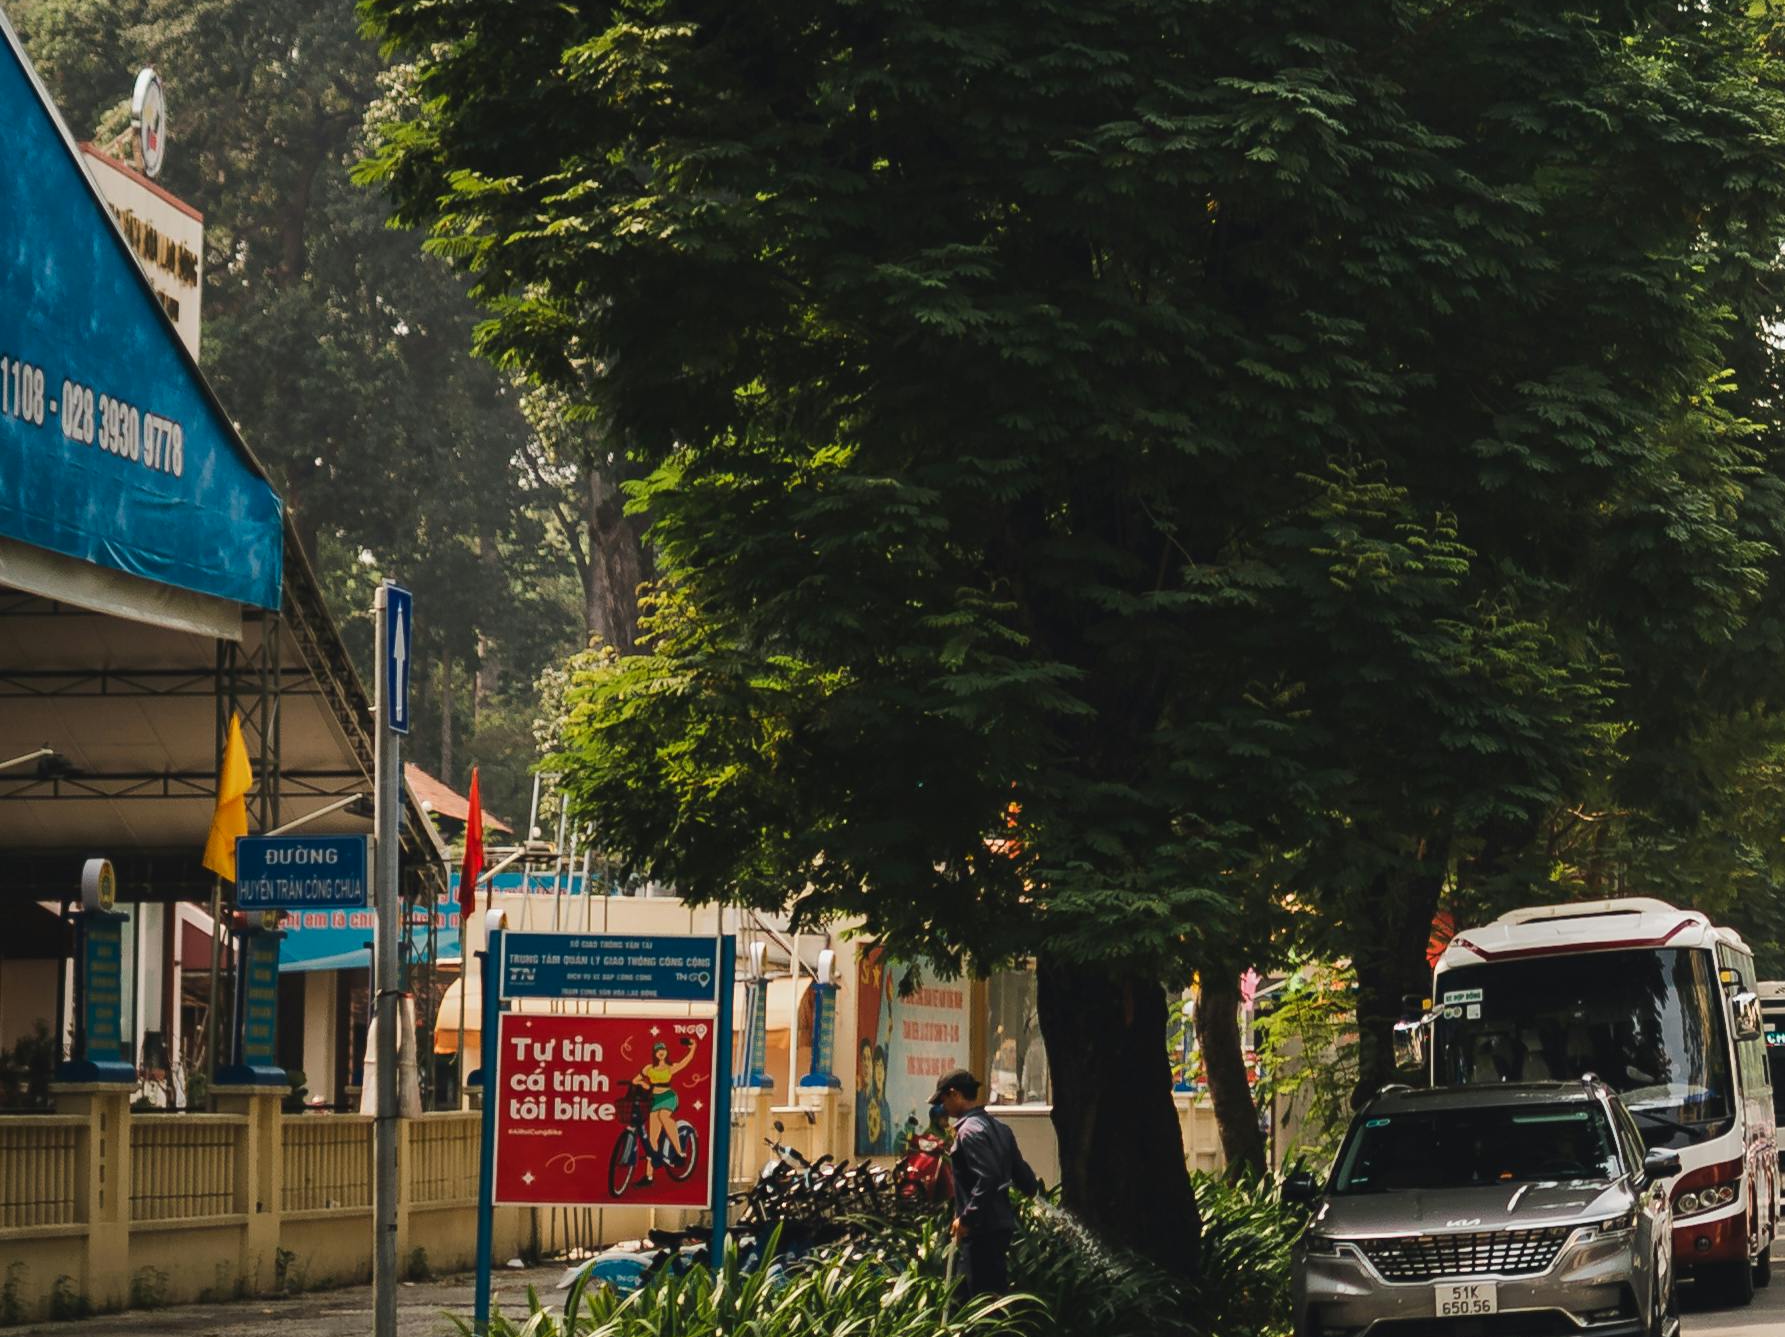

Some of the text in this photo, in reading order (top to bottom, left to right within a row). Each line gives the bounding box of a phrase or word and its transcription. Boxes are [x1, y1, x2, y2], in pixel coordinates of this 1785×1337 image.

[61, 380, 94, 444] 028
[98, 394, 139, 461] 3930
[143, 413, 183, 477] 9778
[265, 845, 338, 865] ĐƯỜNG
[509, 954, 538, 965] TRUNG
[603, 956, 624, 967] GIAO
[510, 1035, 603, 1068] Tự tin
[510, 1068, 609, 1092] cá tính
[509, 1096, 616, 1121] tôi bike
[1452, 1286, 1479, 1300] 51K
[1442, 1300, 1491, 1315] 650.56
